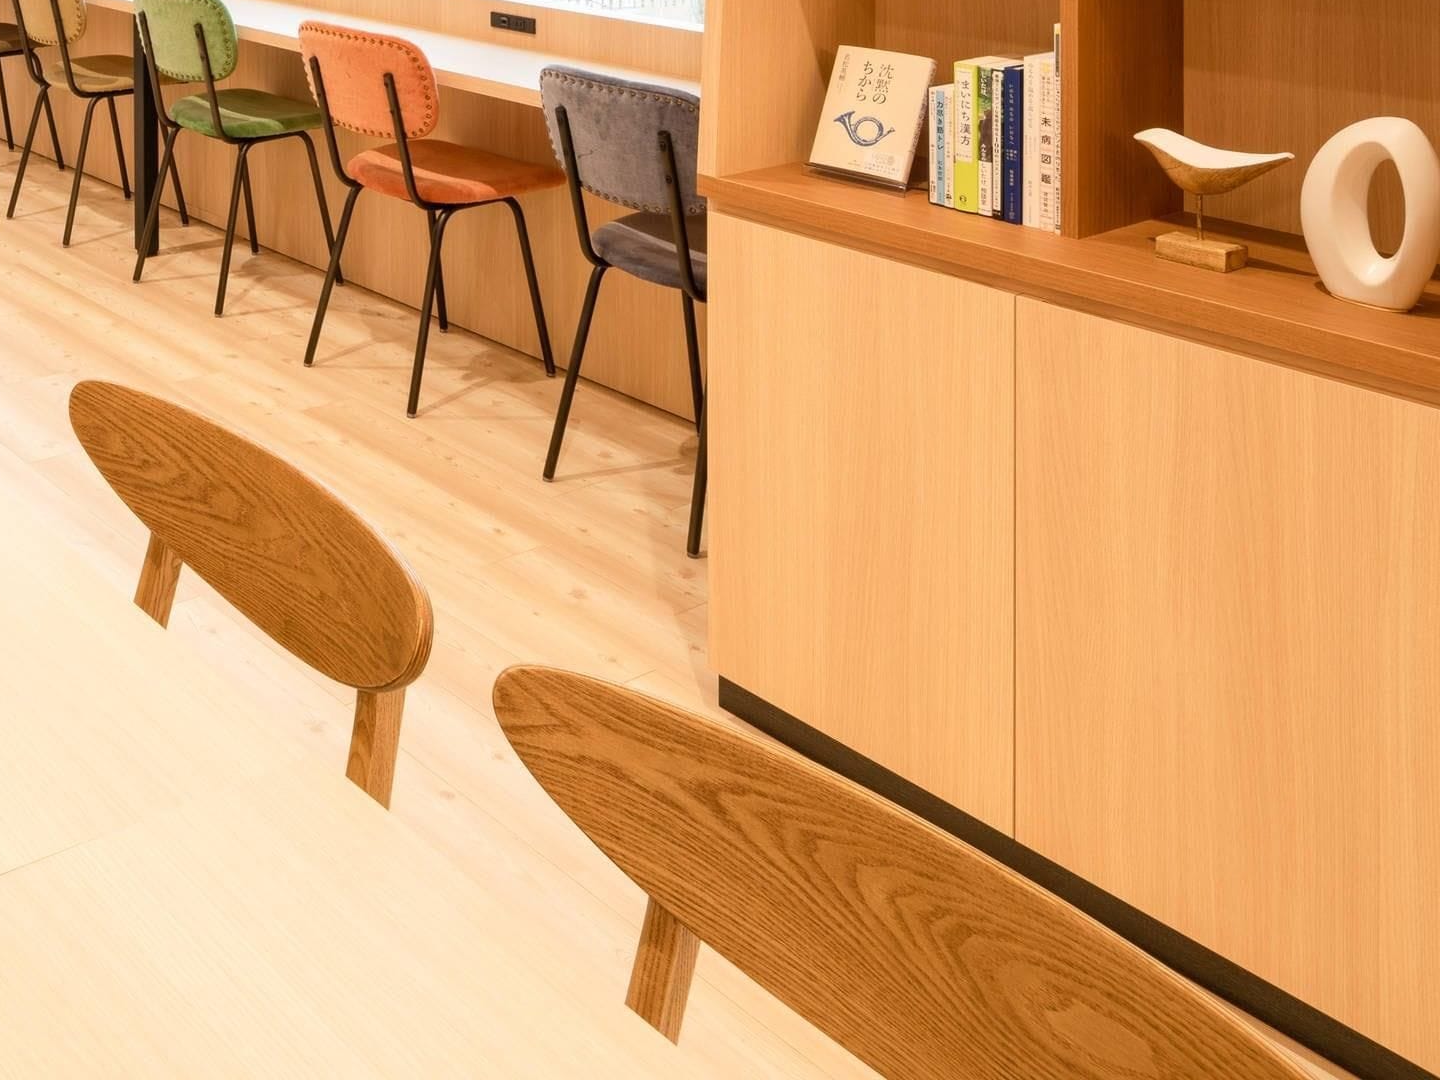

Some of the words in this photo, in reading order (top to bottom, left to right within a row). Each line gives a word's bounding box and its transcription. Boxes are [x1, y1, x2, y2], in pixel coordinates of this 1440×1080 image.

[856, 60, 874, 102] ちから
[872, 63, 895, 105] 沈黙の
[960, 79, 972, 146] まいにち漢方
[1040, 116, 1052, 185] 未病図鑑
